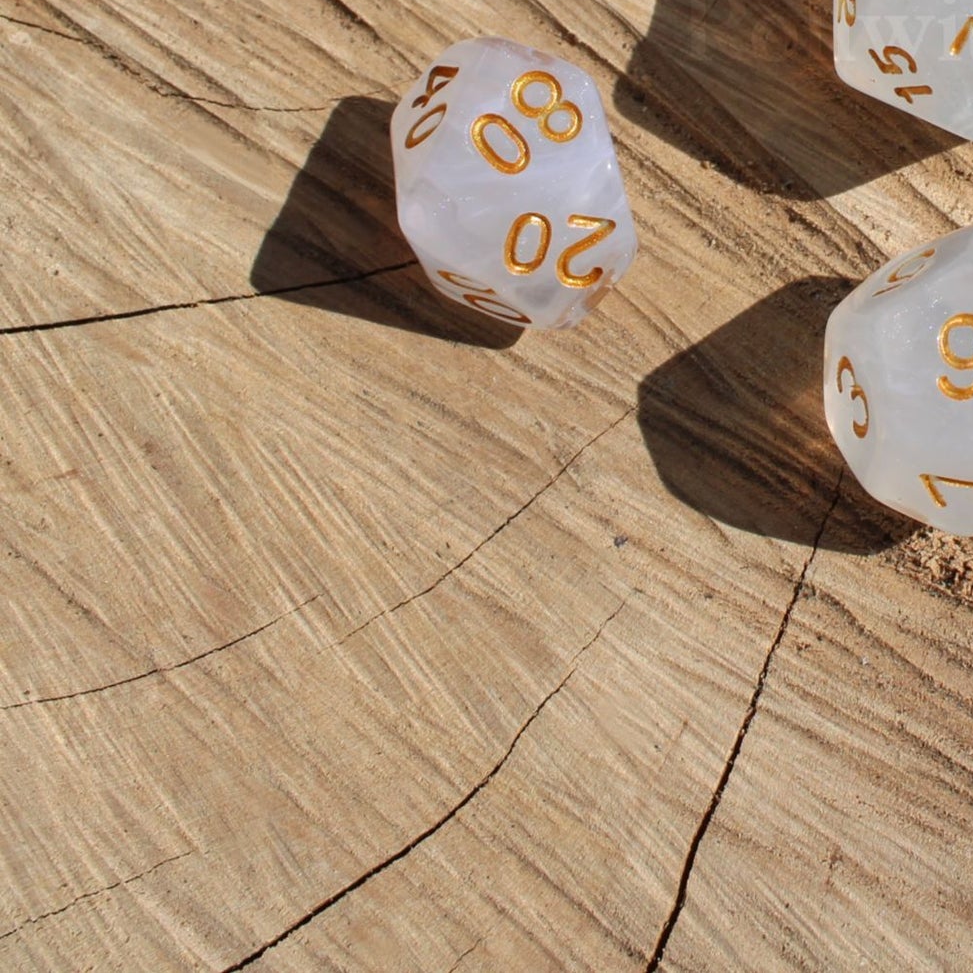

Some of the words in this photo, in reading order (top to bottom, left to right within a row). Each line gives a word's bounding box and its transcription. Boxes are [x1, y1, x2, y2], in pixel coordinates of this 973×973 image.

[868, 45, 933, 104] 15
[470, 69, 584, 175] 80
[504, 212, 617, 289] 20
[836, 356, 869, 439] 3
